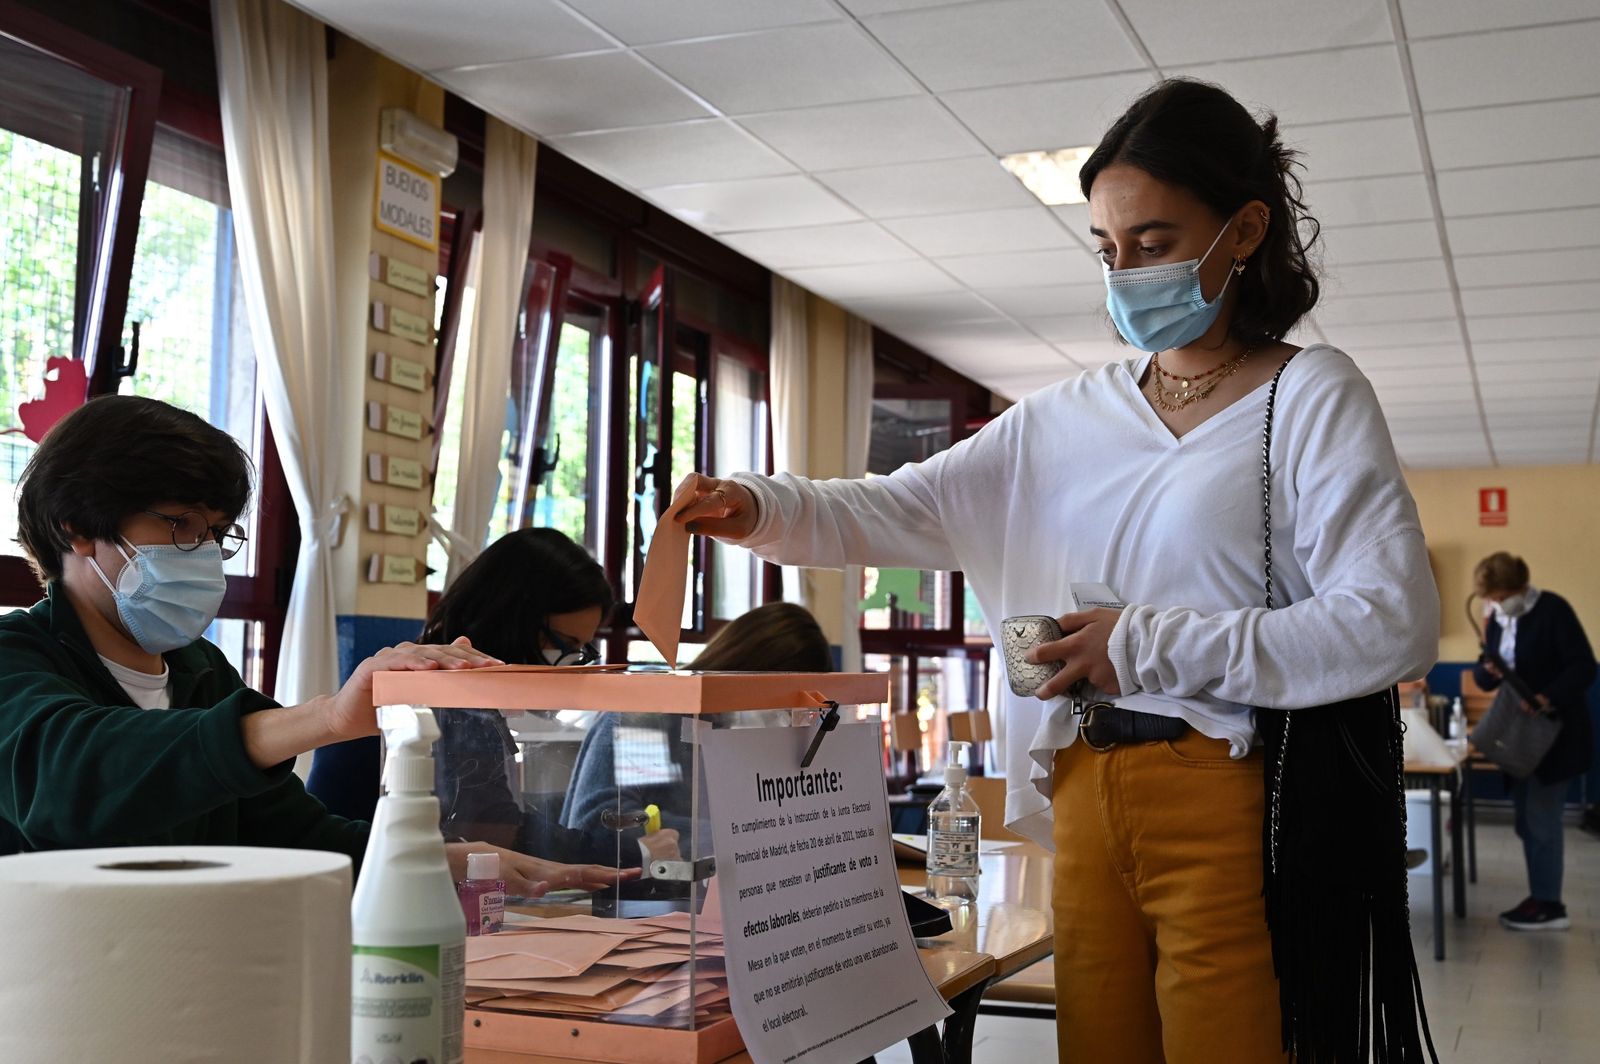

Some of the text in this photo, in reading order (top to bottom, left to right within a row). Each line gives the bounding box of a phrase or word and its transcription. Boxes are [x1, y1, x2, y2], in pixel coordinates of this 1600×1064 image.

[386, 165, 429, 201] BUENOS
[380, 200, 433, 239] MODALES
[756, 769, 843, 807] Importante:
[731, 801, 871, 834] En cumplimiento de la Instrucción de la Junta Electoral
[735, 848, 761, 864] Provincial
[762, 846, 769, 859] de
[769, 843, 790, 857] Madrid,
[790, 841, 797, 853] de
[797, 840, 810, 851] fecha
[809, 837, 817, 849] 20
[817, 837, 824, 847] de
[824, 833, 835, 846] abril
[836, 832, 842, 843] de
[842, 830, 855, 843] 2021,
[855, 828, 868, 839] todas
[739, 855, 879, 901] personas que necesiten un justificante de voto a
[743, 920, 769, 938] efectos
[769, 909, 802, 930] laborales,
[802, 905, 822, 920] deberán
[822, 899, 840, 917] pedirlo
[843, 896, 851, 908] los
[851, 891, 873, 905] miembros
[873, 887, 879, 899] de
[879, 886, 884, 897] la
[747, 917, 892, 972] Mesa en la que voten, en el momento de emitir su voto, ya
[753, 940, 899, 1005] que no se emitirán justificantes de voto una vez abandonado
[762, 1004, 808, 1033] el local electoral.
